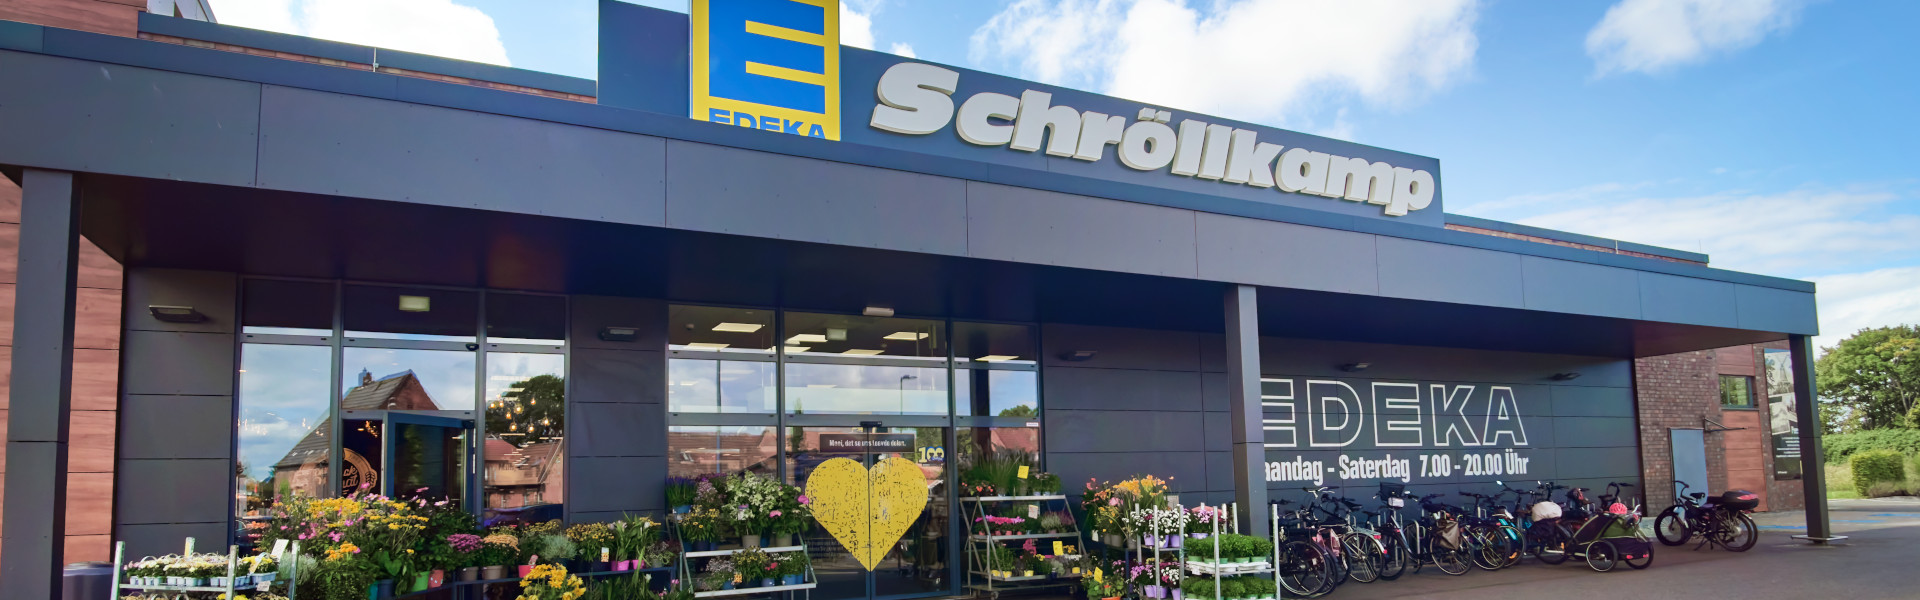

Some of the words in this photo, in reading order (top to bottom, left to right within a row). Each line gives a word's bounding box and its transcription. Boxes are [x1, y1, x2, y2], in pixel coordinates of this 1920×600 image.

[709, 0, 825, 115] E
[870, 62, 1435, 217] Schröllkamp
[1260, 377, 1529, 448] EDEKA
[1338, 453, 1411, 483] Saterdag
[1419, 454, 1451, 477] 7.00
[1463, 453, 1502, 476] 20.00
